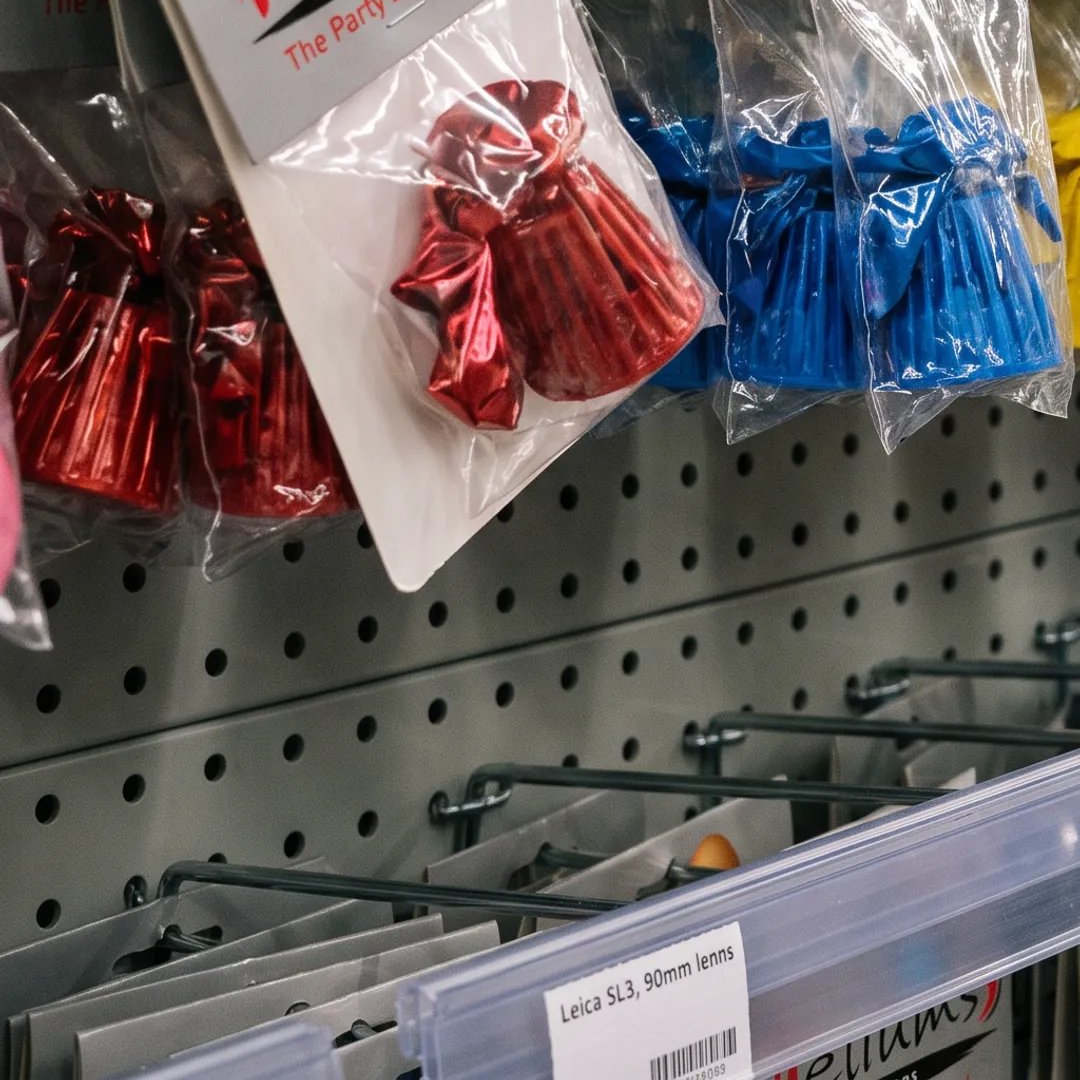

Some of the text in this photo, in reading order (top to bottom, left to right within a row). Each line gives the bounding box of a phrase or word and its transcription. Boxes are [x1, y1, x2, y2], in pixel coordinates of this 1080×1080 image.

[283, 32, 329, 72] The
[560, 945, 735, 1024] Leica SL3, 90mm lenns
